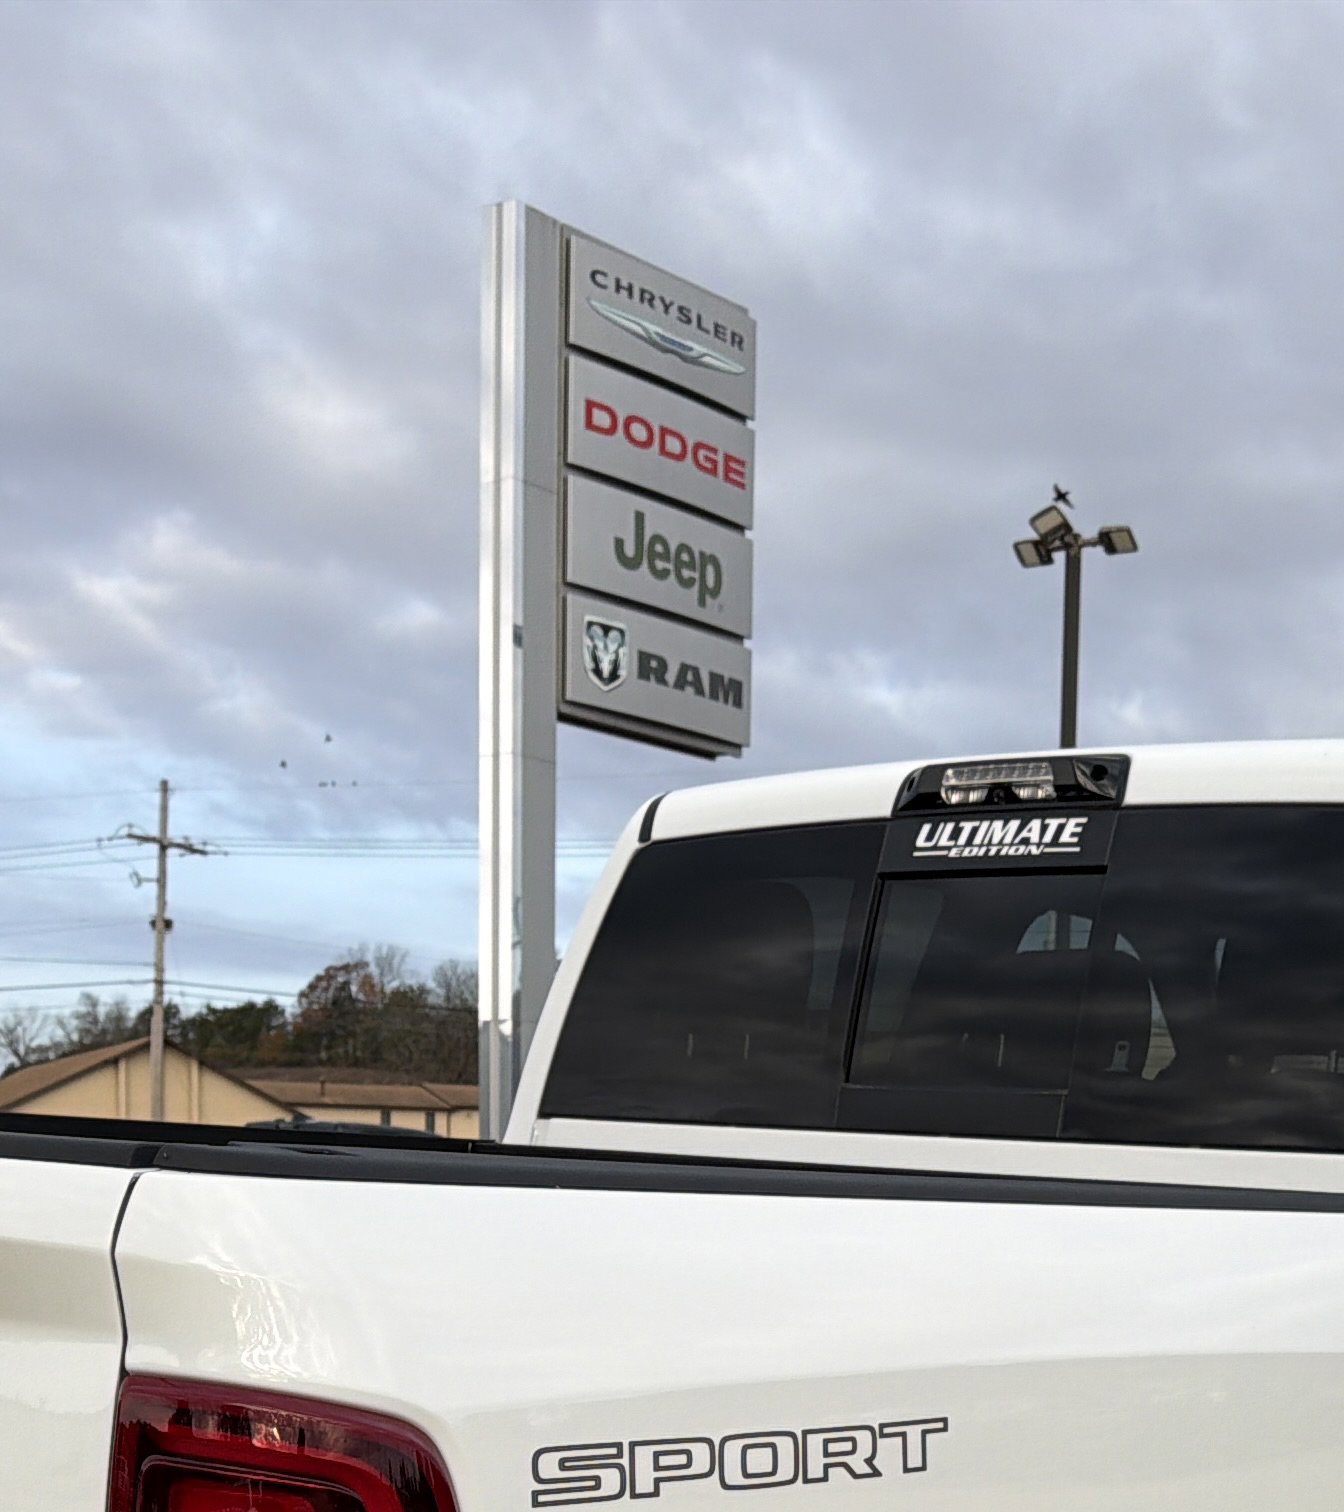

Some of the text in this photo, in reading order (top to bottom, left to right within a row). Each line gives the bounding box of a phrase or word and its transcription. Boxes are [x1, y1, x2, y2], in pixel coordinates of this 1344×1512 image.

[589, 268, 744, 351] CHRYSLER
[584, 398, 747, 491] DODGE
[613, 509, 723, 608] Jeep
[636, 649, 743, 710] RAM
[915, 816, 1088, 848] ULTIMATE
[947, 843, 1045, 858] EDITION
[531, 1416, 949, 1509] SPORT
